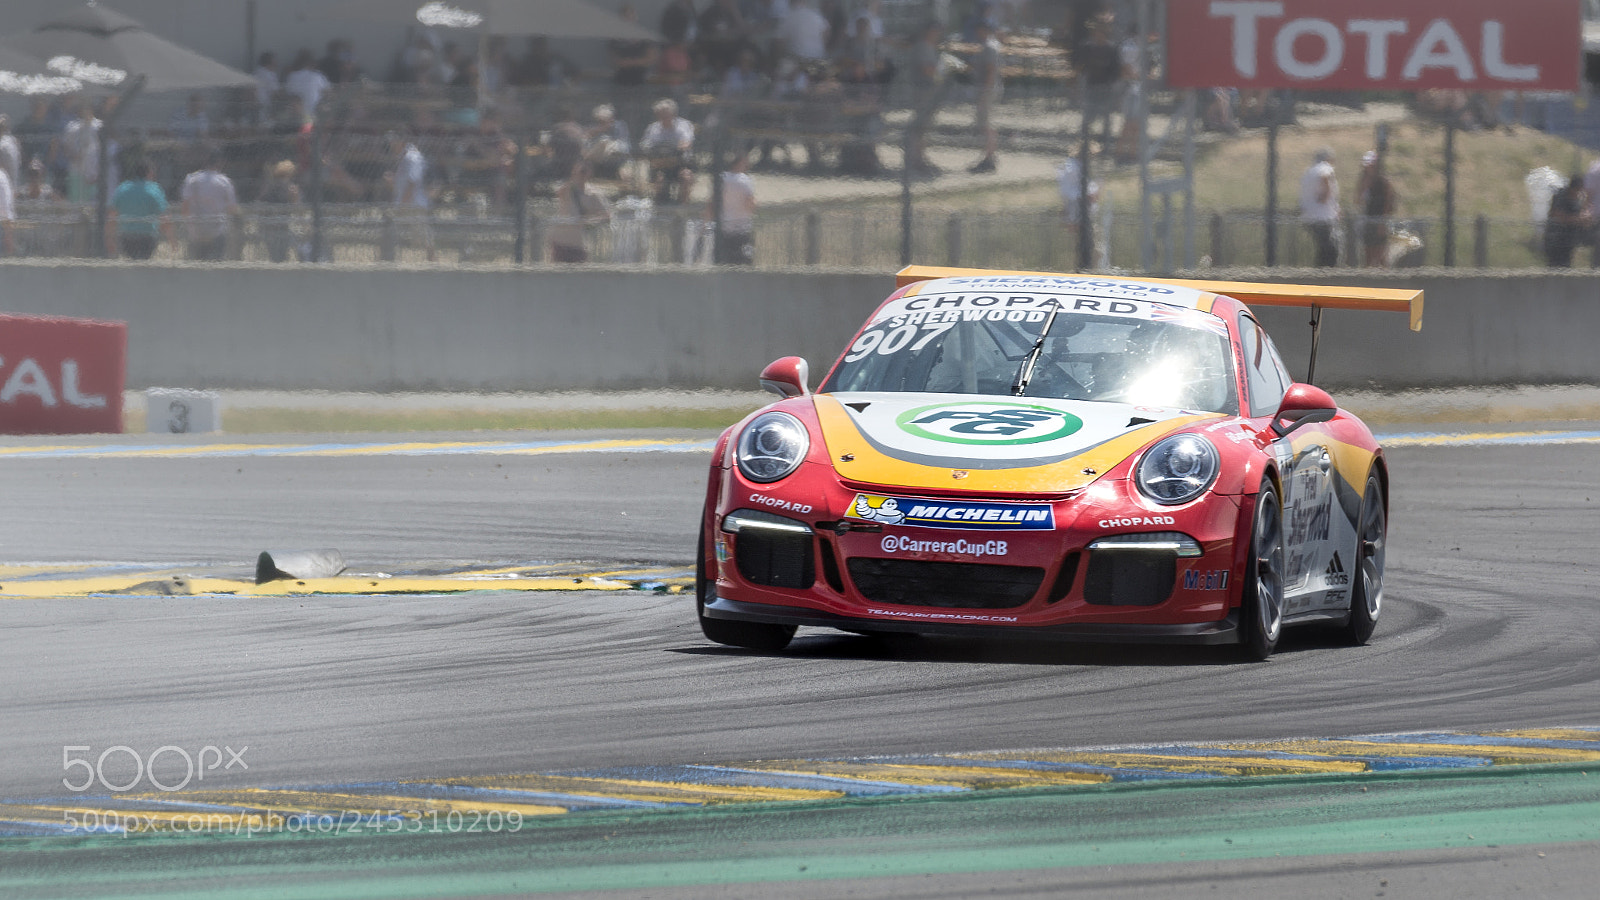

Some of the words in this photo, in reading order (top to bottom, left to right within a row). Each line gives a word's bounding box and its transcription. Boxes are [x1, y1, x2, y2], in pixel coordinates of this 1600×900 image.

[1209, 1, 1540, 82] TOTAL
[949, 276, 1175, 295] SHERWOOD
[1108, 288, 1148, 297] LTD
[904, 295, 1139, 314] CHOPARD
[889, 309, 1047, 328] SHERWOOD
[844, 321, 957, 363] 907
[0, 355, 107, 408] AL
[168, 399, 189, 434] 3
[748, 493, 813, 514] CHOPARD
[907, 505, 1050, 521] MICHELIN
[1098, 516, 1176, 528] CHOPARD
[880, 535, 1009, 556] @CarreraCupGB
[1325, 572, 1349, 586] adidas
